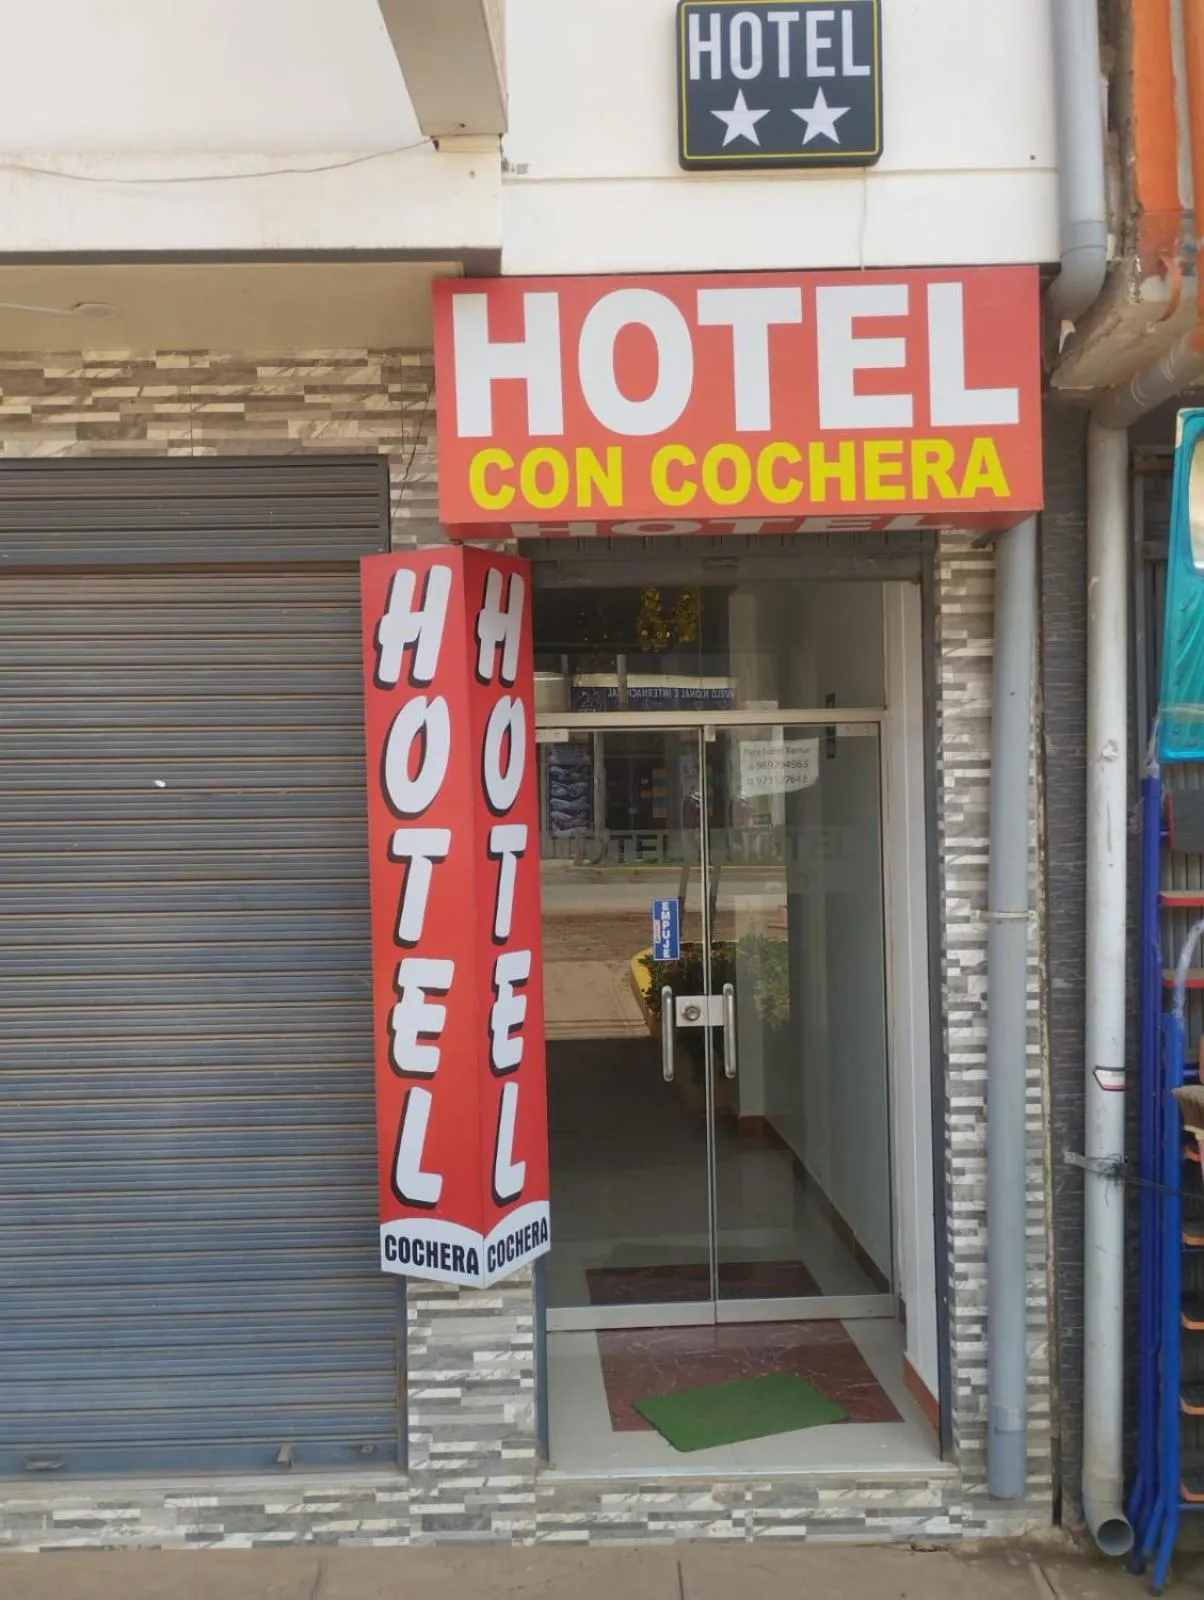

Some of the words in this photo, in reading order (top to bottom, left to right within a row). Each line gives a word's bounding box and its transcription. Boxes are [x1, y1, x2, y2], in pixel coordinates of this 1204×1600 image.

[688, 9, 870, 80] HOTEL
[451, 281, 1020, 438] HOTEL
[468, 445, 623, 511] CON
[650, 437, 1011, 506] COCHERA
[510, 515, 953, 537] HOTEL
[373, 564, 453, 1209] HOTEL
[475, 566, 529, 1207] HOTEL
[660, 901, 671, 959] EMPUJE
[385, 1234, 479, 1275] COCHERA
[487, 1216, 548, 1273] COCHERA
